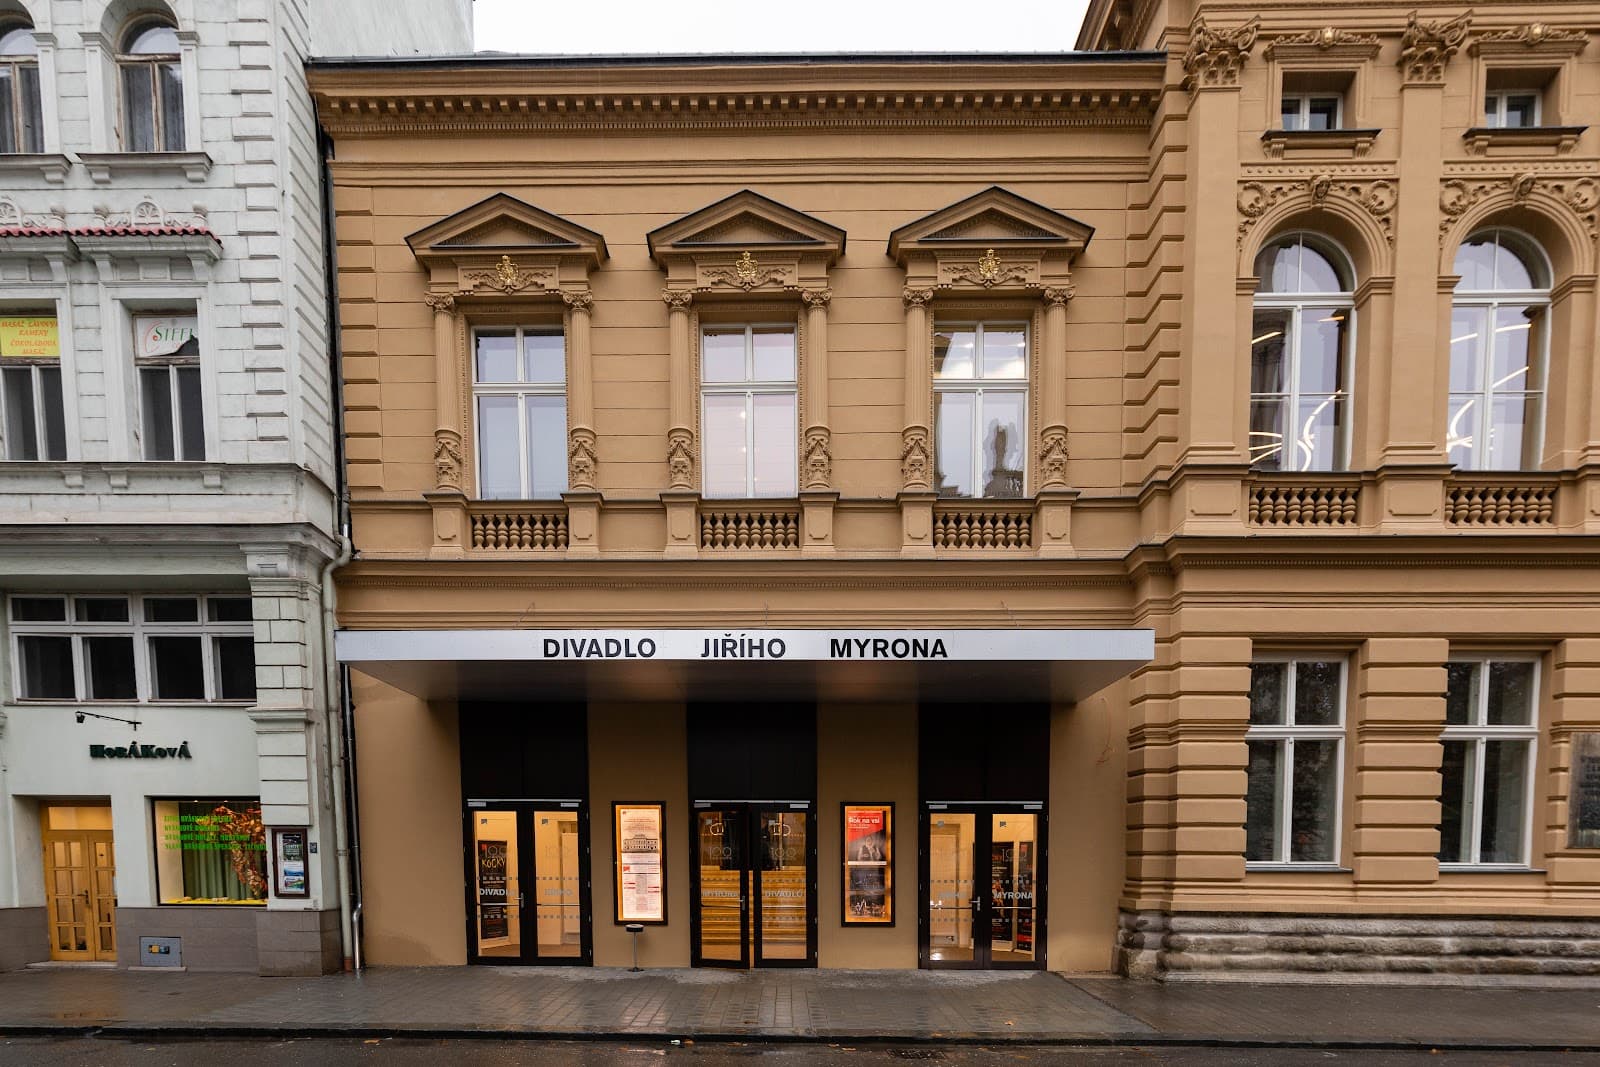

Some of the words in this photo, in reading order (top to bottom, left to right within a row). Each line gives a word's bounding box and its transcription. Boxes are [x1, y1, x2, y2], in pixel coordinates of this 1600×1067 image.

[542, 637, 656, 658] DIVADLO
[700, 633, 787, 658] JIŘÍHO
[829, 637, 948, 658] MYRONA
[992, 891, 1032, 900] MYRONA
